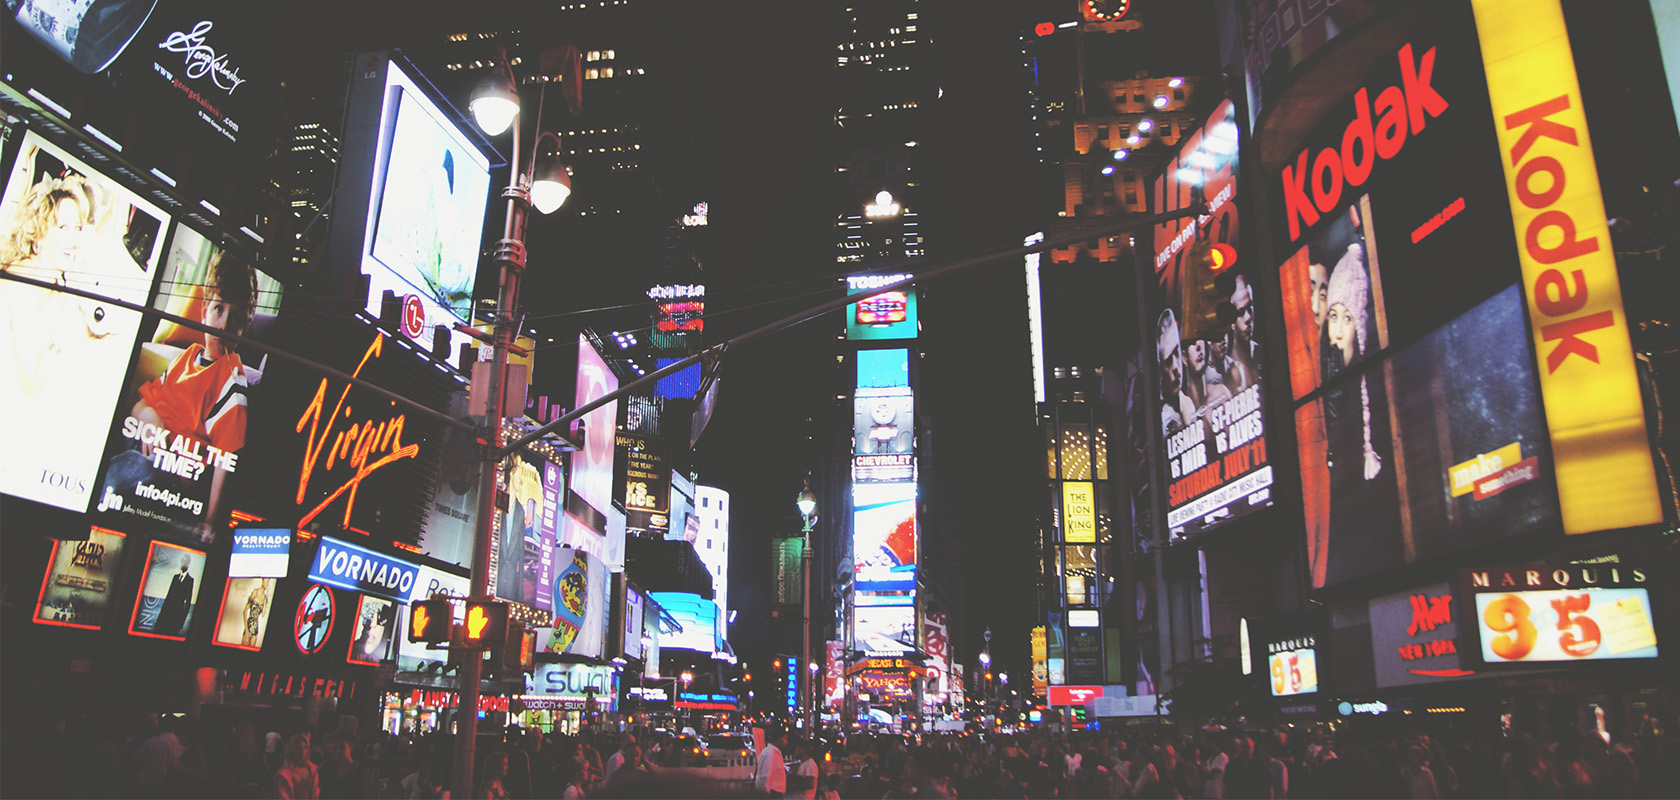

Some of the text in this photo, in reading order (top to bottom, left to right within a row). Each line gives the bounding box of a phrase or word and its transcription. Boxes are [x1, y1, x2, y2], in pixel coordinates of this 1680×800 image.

[364, 71, 376, 79] LG
[1281, 42, 1449, 242] Kodak
[1503, 93, 1615, 376] Kodak
[1156, 245, 1171, 268] LIVE
[1170, 234, 1183, 253] ON
[846, 273, 913, 290] TOSHI
[1212, 383, 1261, 434] ST-PIERRE
[296, 333, 419, 528] Virgin
[615, 435, 645, 450] WHO IS
[1167, 419, 1206, 460] LESNAR
[1229, 410, 1264, 450] ALVES
[122, 416, 239, 473] SICK ALL THE
[152, 447, 205, 481] TIME?
[856, 454, 912, 467] CHEVROLET
[1169, 460, 1223, 507] SATURDAY,
[1223, 444, 1251, 481] JULY
[1252, 436, 1267, 467] 11
[1181, 443, 1207, 476] MIR
[1452, 453, 1503, 489] make
[41, 469, 87, 495] TOUS
[1479, 465, 1533, 495] something
[135, 481, 203, 515] info4pi.org
[1067, 504, 1090, 518] LION
[1070, 493, 1087, 501] THE
[434, 502, 470, 523] TIMES SQUARE
[233, 535, 291, 545] VORNADO
[1068, 520, 1091, 535] KING
[319, 546, 414, 593] VORNADO
[1472, 567, 1647, 588] MARQUIS
[864, 649, 904, 658] Panasonic
[1268, 636, 1315, 653] MARQUIS
[1398, 639, 1457, 661] NEW YORK
[412, 688, 452, 709] PLANET
